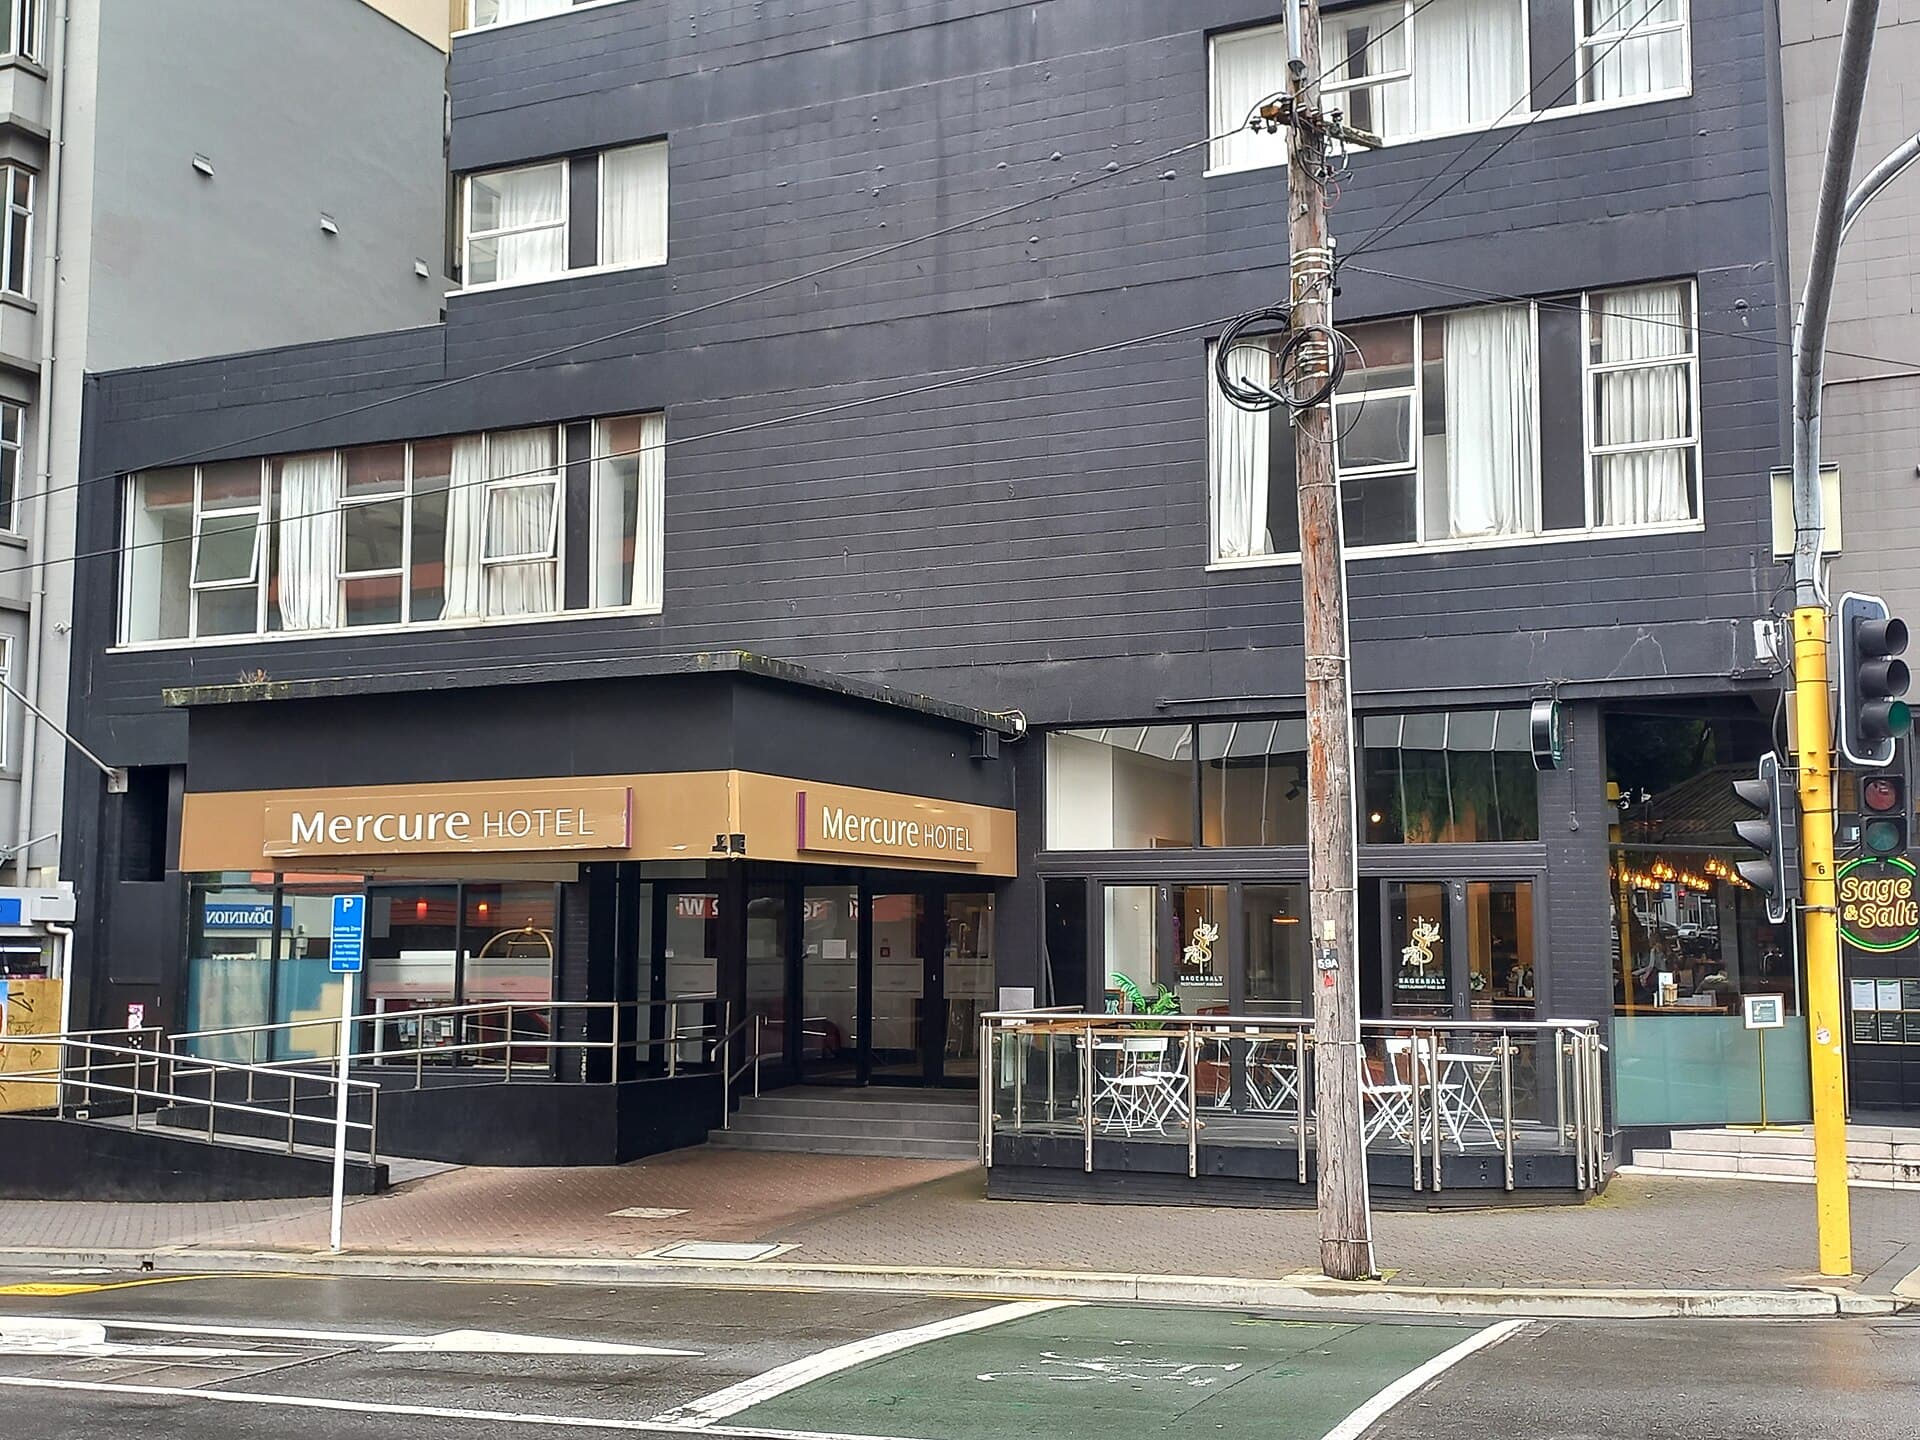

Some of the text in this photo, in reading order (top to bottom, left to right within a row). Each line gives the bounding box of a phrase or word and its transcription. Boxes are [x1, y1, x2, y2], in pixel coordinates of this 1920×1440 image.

[291, 808, 594, 844] Mercure HOTEL
[822, 806, 974, 852] Mercure HOTEL
[1818, 865, 1825, 875] 6
[343, 898, 353, 913] P
[1840, 876, 1912, 906] Sage
[1843, 900, 1919, 929] & Salt
[1323, 948, 1331, 959] F
